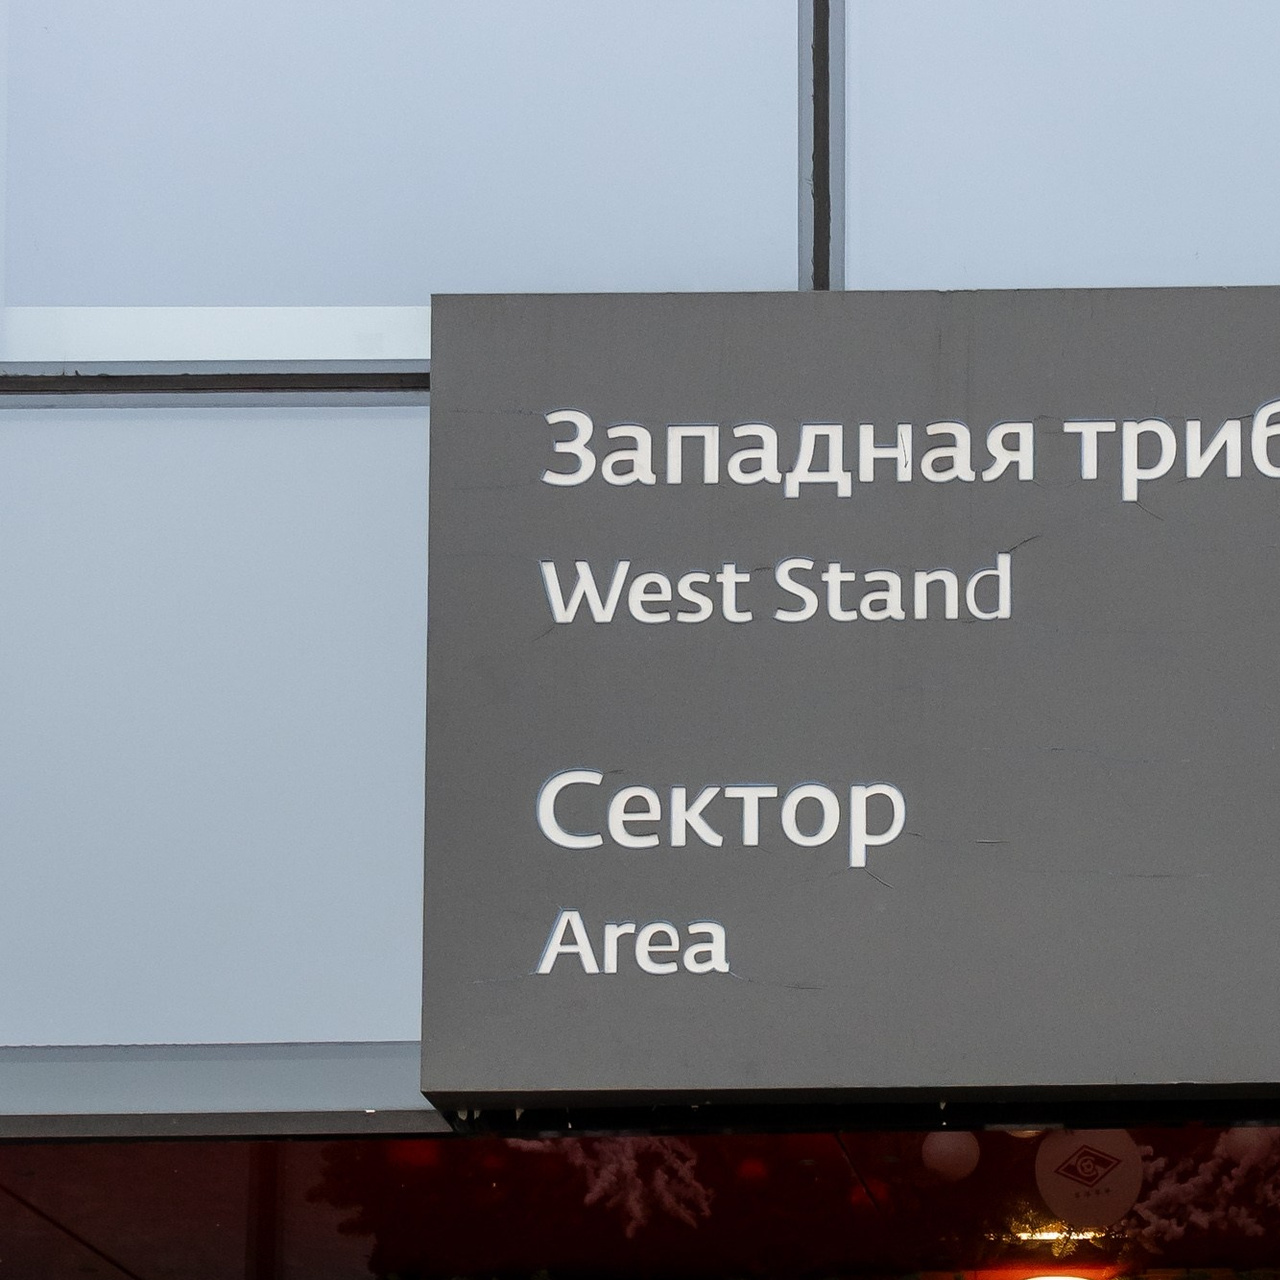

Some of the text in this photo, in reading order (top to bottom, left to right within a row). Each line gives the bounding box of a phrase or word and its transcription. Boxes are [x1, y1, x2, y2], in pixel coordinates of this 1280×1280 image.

[542, 407, 1034, 498] Западная
[541, 552, 1012, 624] West Stand
[536, 769, 907, 868] Сектор
[536, 908, 731, 975] Area
